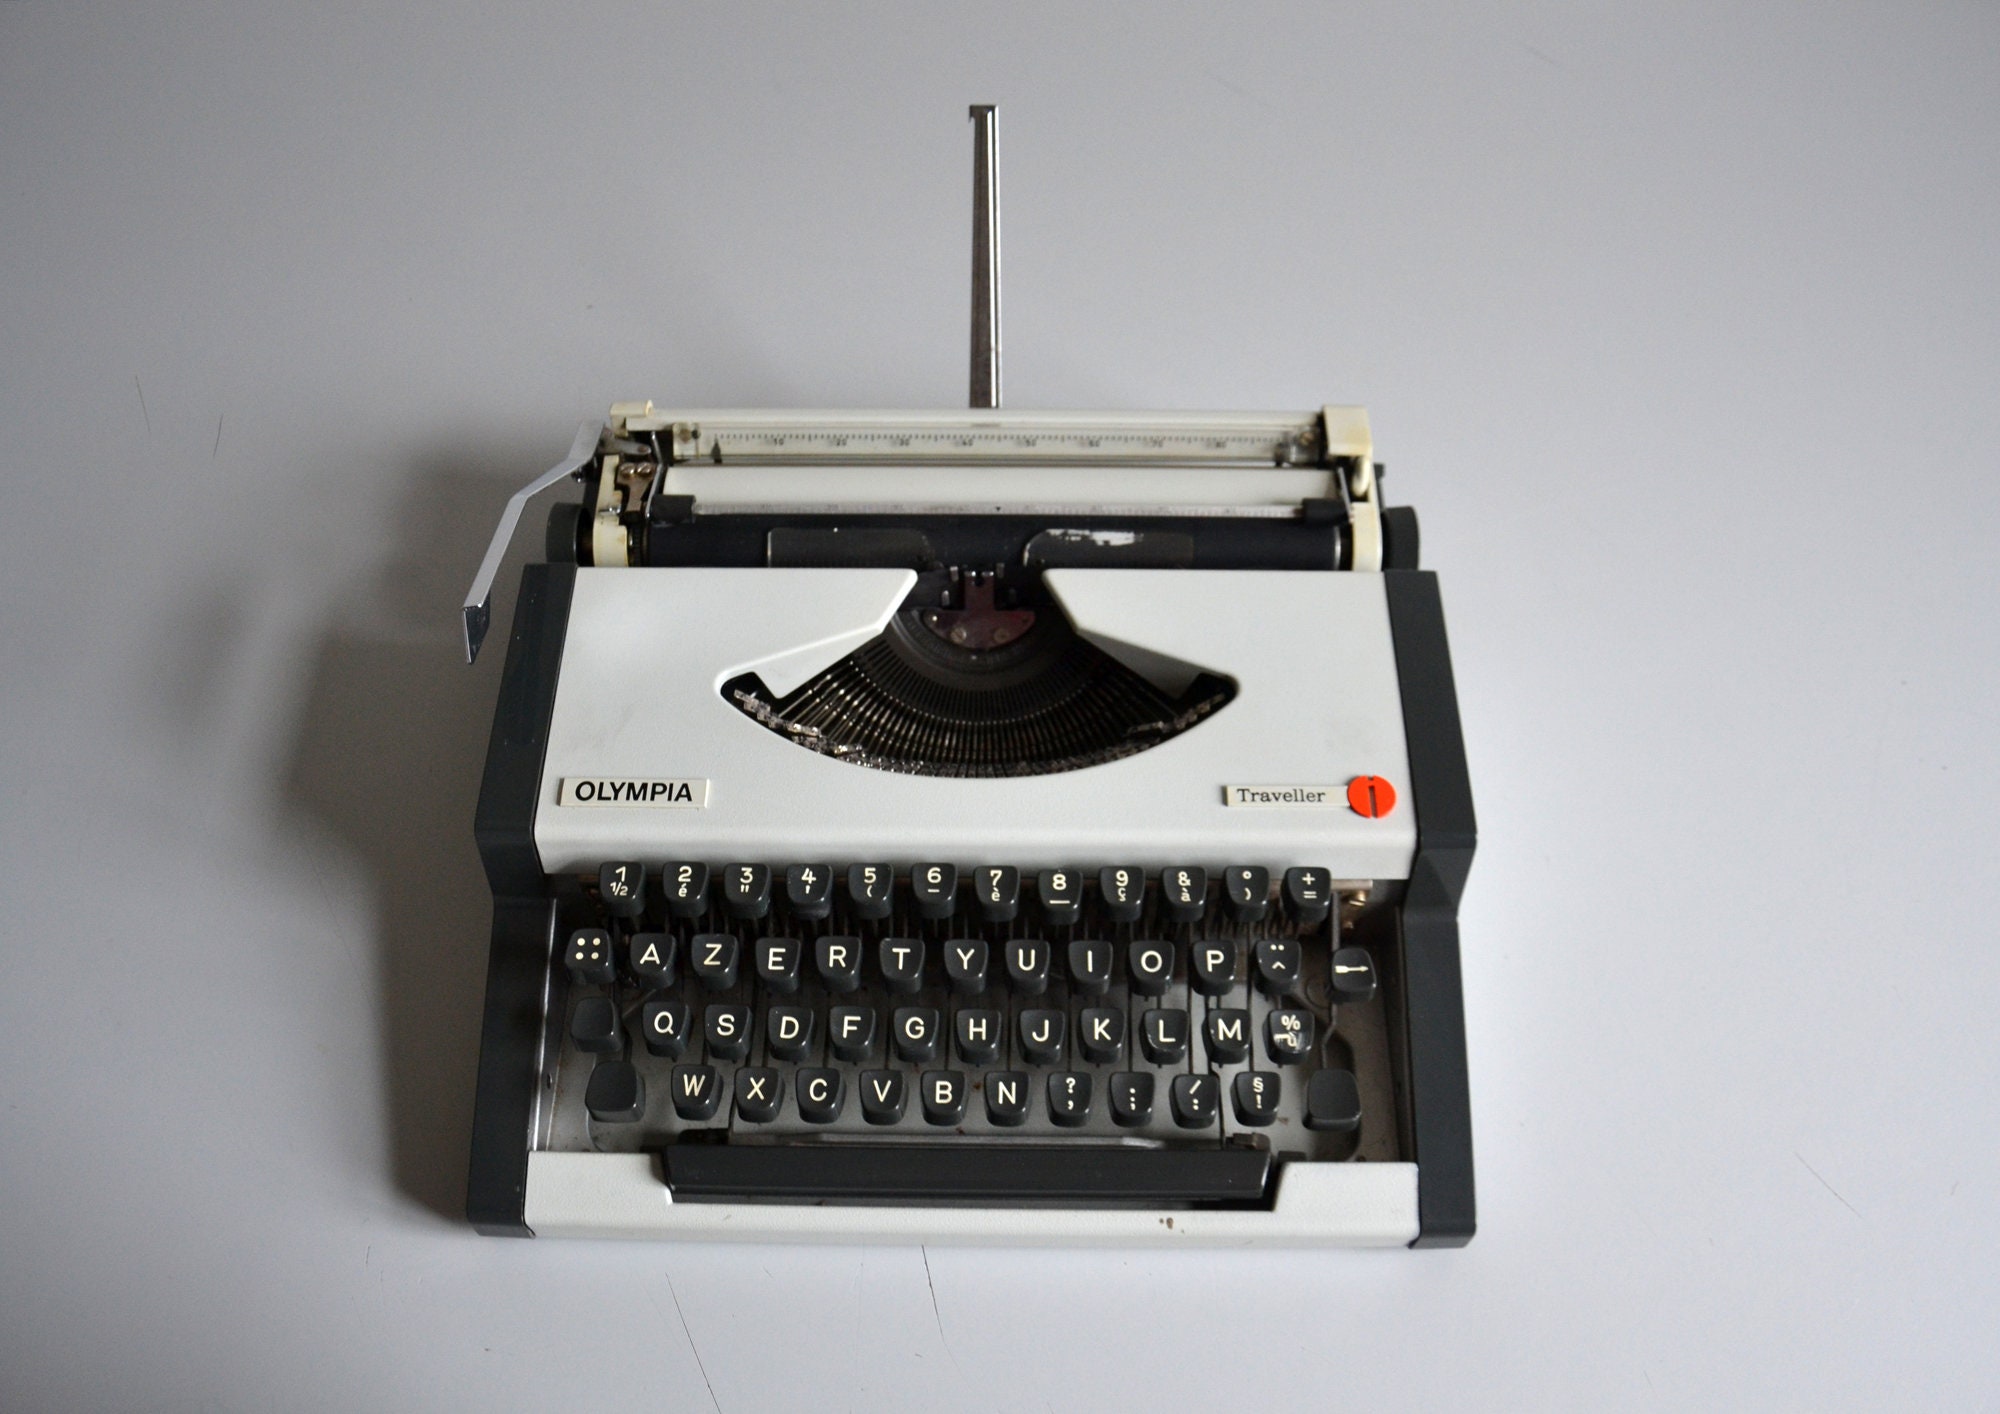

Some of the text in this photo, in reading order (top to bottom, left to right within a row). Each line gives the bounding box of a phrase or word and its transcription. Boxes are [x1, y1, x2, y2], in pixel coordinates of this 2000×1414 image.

[575, 780, 693, 802] OLYMPIA
[1236, 788, 1326, 803] Traveller
[615, 866, 626, 882] 1
[677, 865, 692, 882] 2
[740, 867, 753, 883] 3
[801, 867, 817, 884] 4
[864, 867, 877, 884] 5
[927, 867, 941, 884] 6
[991, 869, 1003, 887] 7
[1053, 873, 1067, 890] 8
[1116, 870, 1128, 887] 9
[1179, 870, 1191, 887] &
[1302, 872, 1315, 885] +
[679, 882, 688, 898] é
[639, 942, 661, 965] A
[703, 943, 722, 966] Z
[767, 947, 785, 971] E
[829, 945, 847, 968] R
[891, 947, 911, 971] T
[956, 948, 975, 971] Y
[1018, 948, 1036, 971] U
[1087, 950, 1093, 973] I
[1140, 950, 1163, 973] O
[1206, 949, 1225, 973] P
[653, 1011, 674, 1035] Q
[716, 1013, 735, 1036] S
[779, 1015, 799, 1039] D
[842, 1015, 862, 1039] F
[905, 1016, 925, 1040] G
[968, 1017, 987, 1041] H
[1031, 1019, 1050, 1042] J
[1093, 1017, 1112, 1041] K
[1158, 1019, 1176, 1043] L
[1217, 1018, 1242, 1041] M
[1280, 1014, 1301, 1031] %
[683, 1073, 706, 1097] W
[746, 1076, 766, 1100] X
[810, 1078, 828, 1102] C
[873, 1079, 892, 1103] V
[935, 1080, 953, 1104] B
[998, 1081, 1017, 1105] N
[1066, 1077, 1076, 1094] ?
